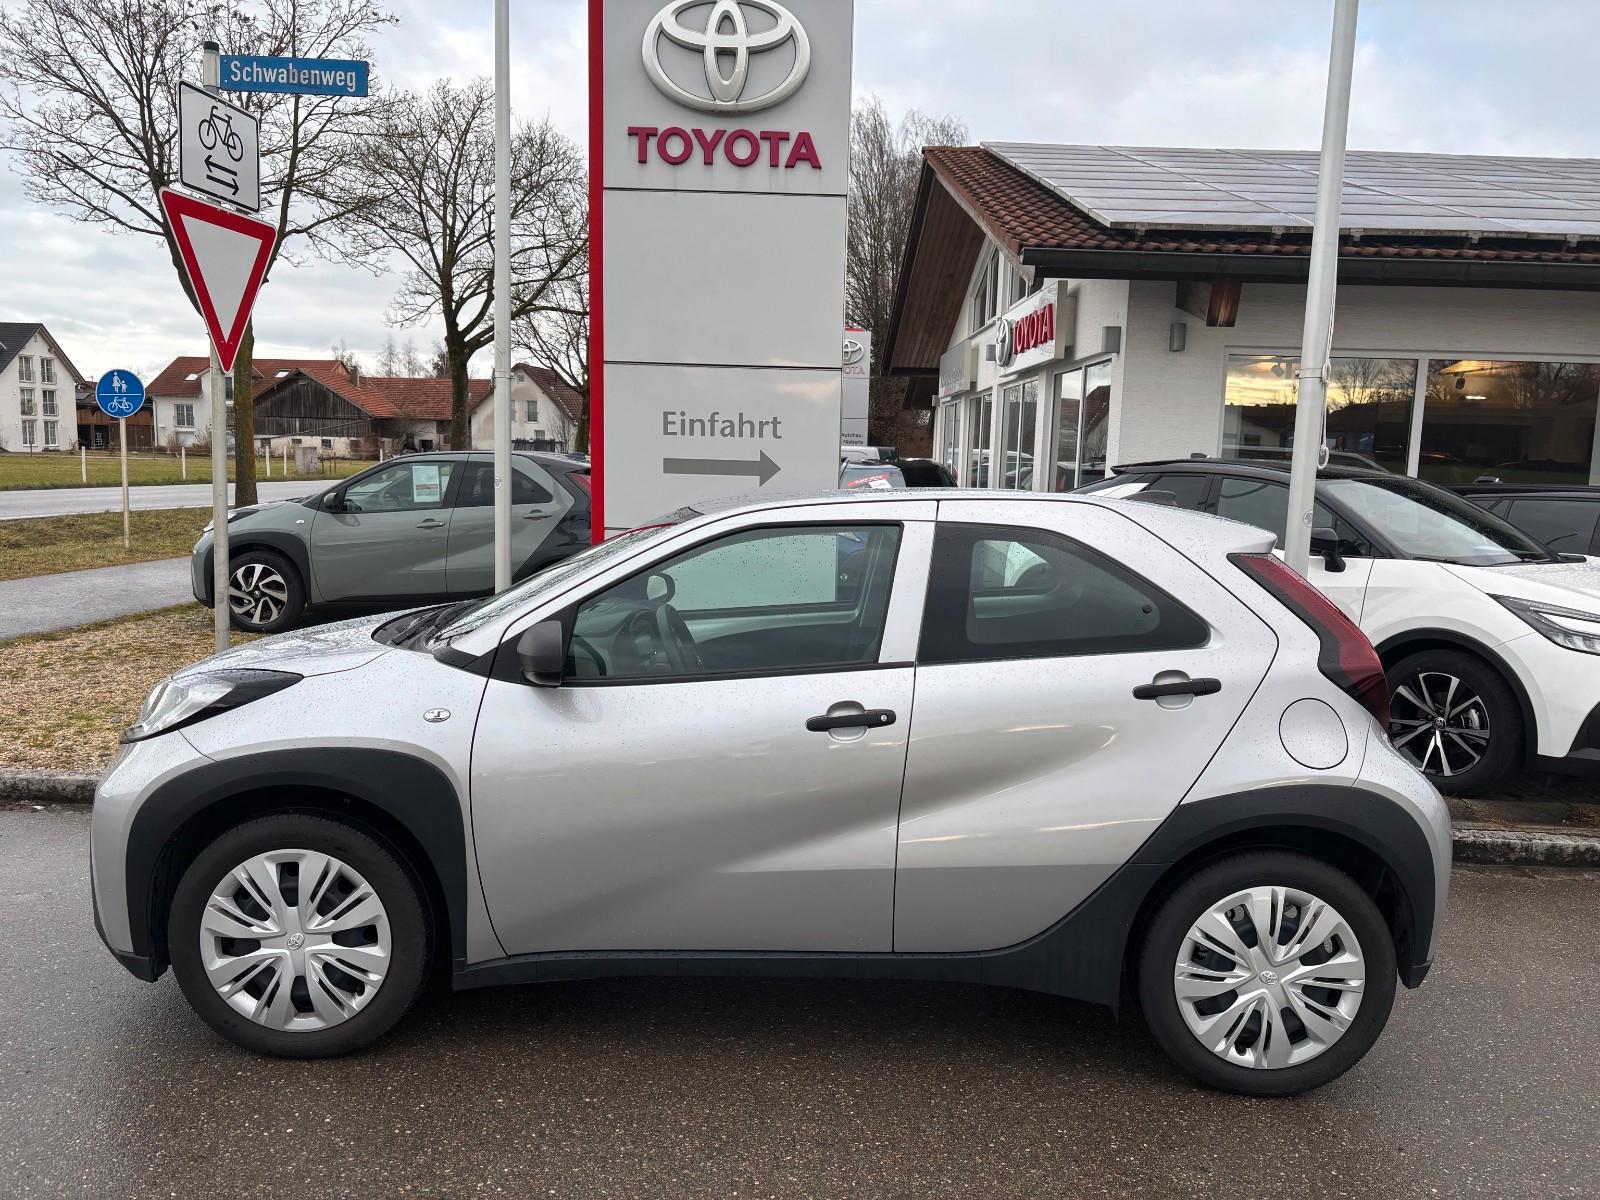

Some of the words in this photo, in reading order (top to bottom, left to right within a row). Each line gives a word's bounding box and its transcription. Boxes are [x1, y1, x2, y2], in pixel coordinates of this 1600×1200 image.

[230, 60, 356, 92] Schwabenweg
[628, 126, 822, 169] TOYOTA
[1013, 303, 1055, 354] TOYOTA
[843, 366, 865, 375] OTA
[663, 411, 782, 439] Einfahrt
